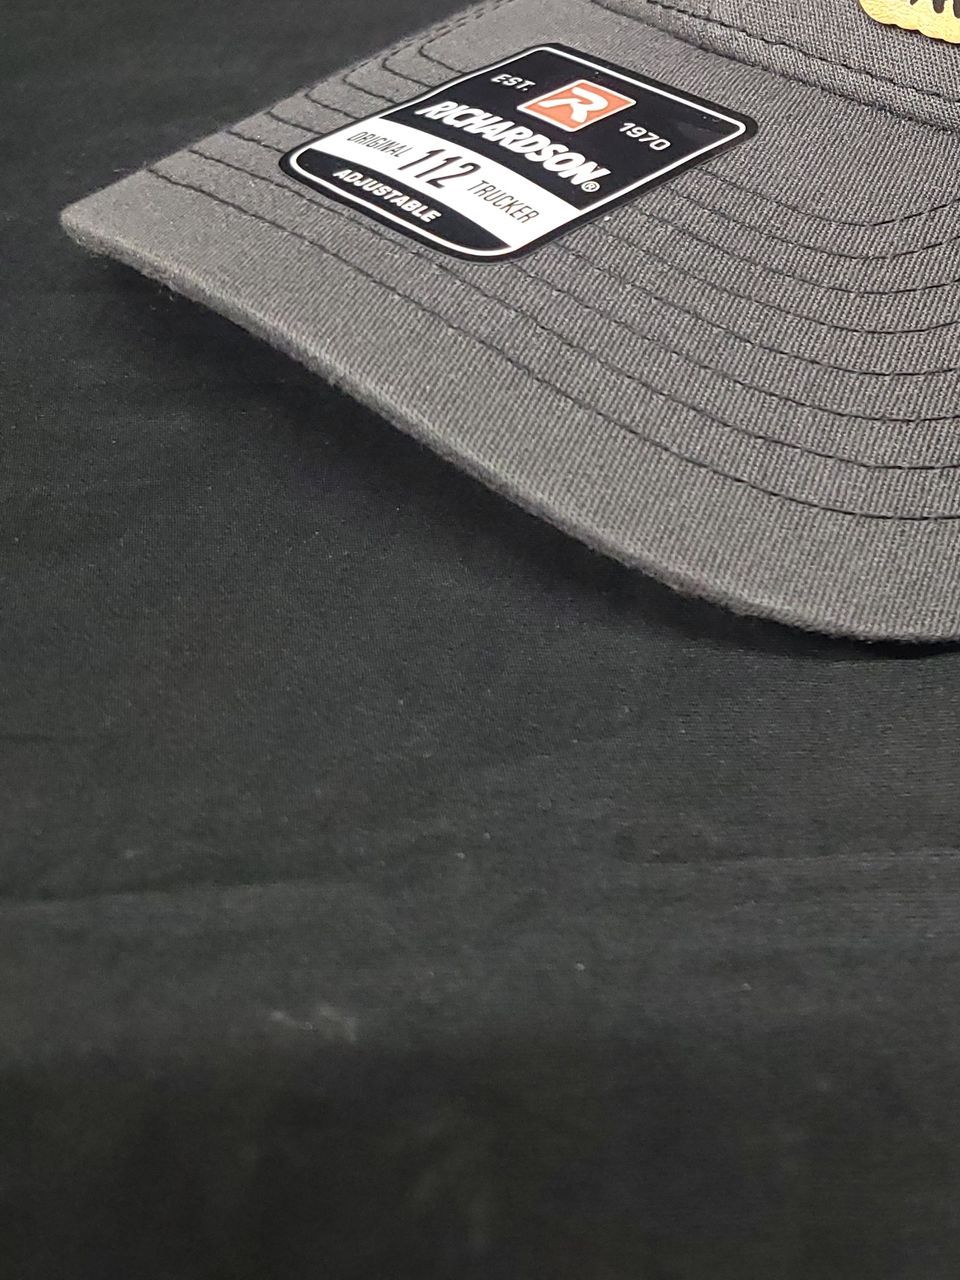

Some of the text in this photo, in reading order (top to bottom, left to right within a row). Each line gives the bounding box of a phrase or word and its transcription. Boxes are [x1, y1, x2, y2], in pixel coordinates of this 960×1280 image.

[491, 73, 671, 151] EST. 1970
[332, 169, 442, 223] ADJUSTABLE
[347, 131, 540, 224] ORIGINAL 112 TRUCKER
